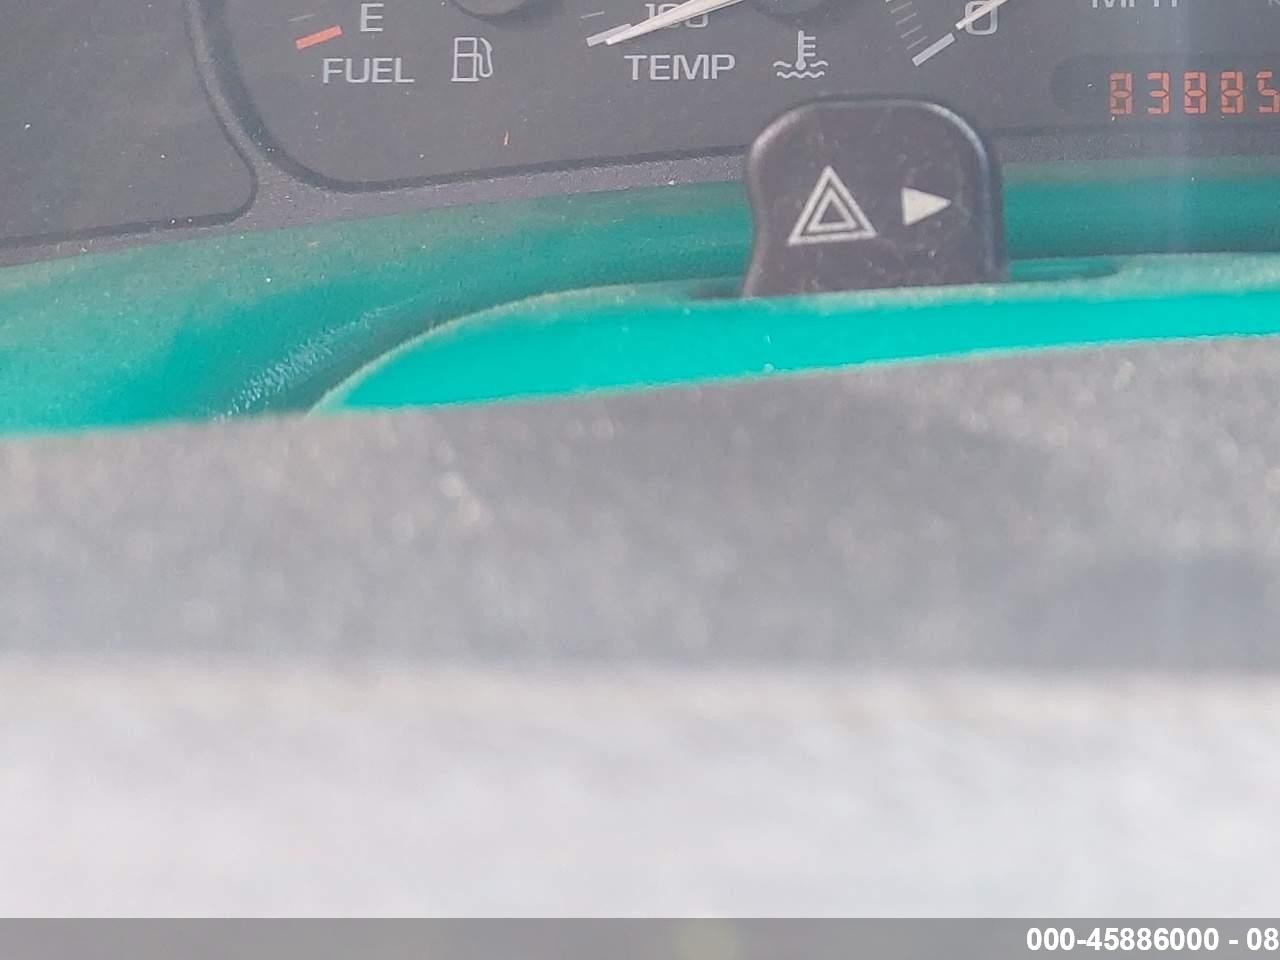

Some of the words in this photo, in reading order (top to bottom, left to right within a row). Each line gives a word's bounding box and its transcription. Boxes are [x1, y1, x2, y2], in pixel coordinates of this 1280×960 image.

[360, 2, 384, 32] E
[964, 0, 998, 35] 0
[322, 57, 415, 84] FUEL
[624, 53, 736, 80] TEMP
[1109, 71, 1280, 115] 83885
